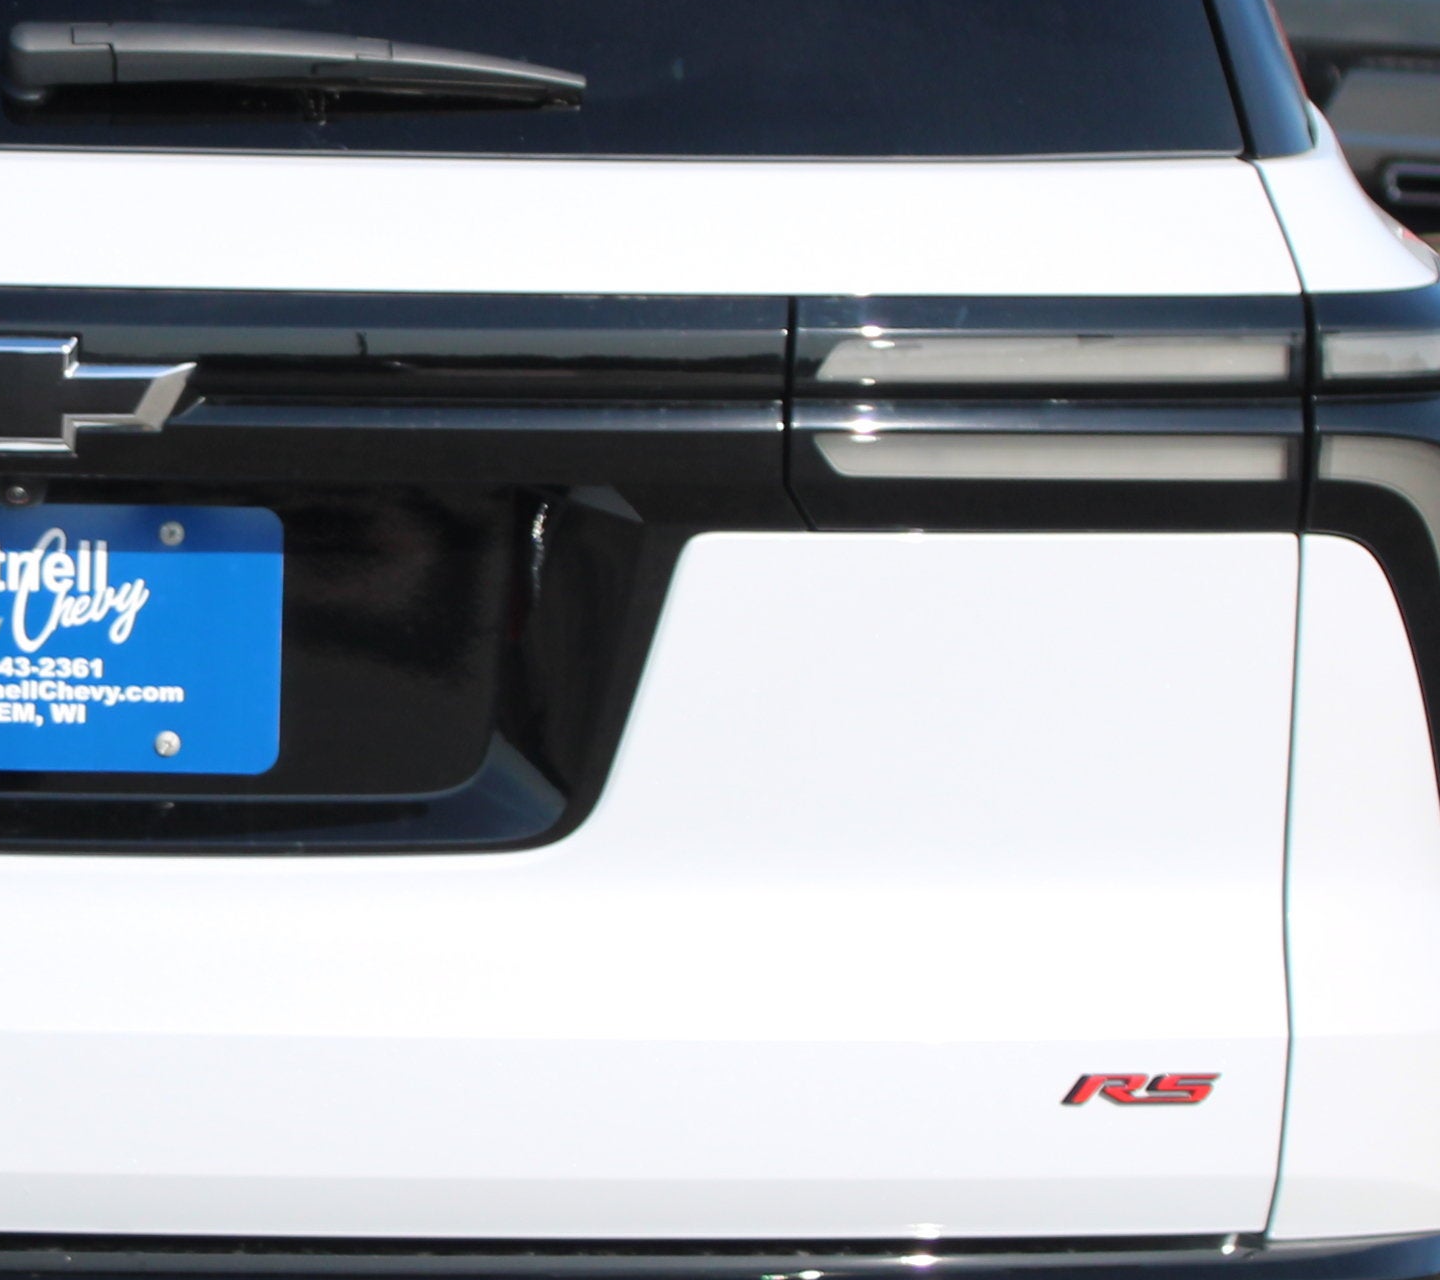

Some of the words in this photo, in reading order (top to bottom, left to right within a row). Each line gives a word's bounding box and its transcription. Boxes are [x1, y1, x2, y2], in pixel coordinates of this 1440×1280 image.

[12, 527, 150, 653] Chevy
[50, 703, 87, 725] WI
[1061, 1073, 1221, 1106] RS
